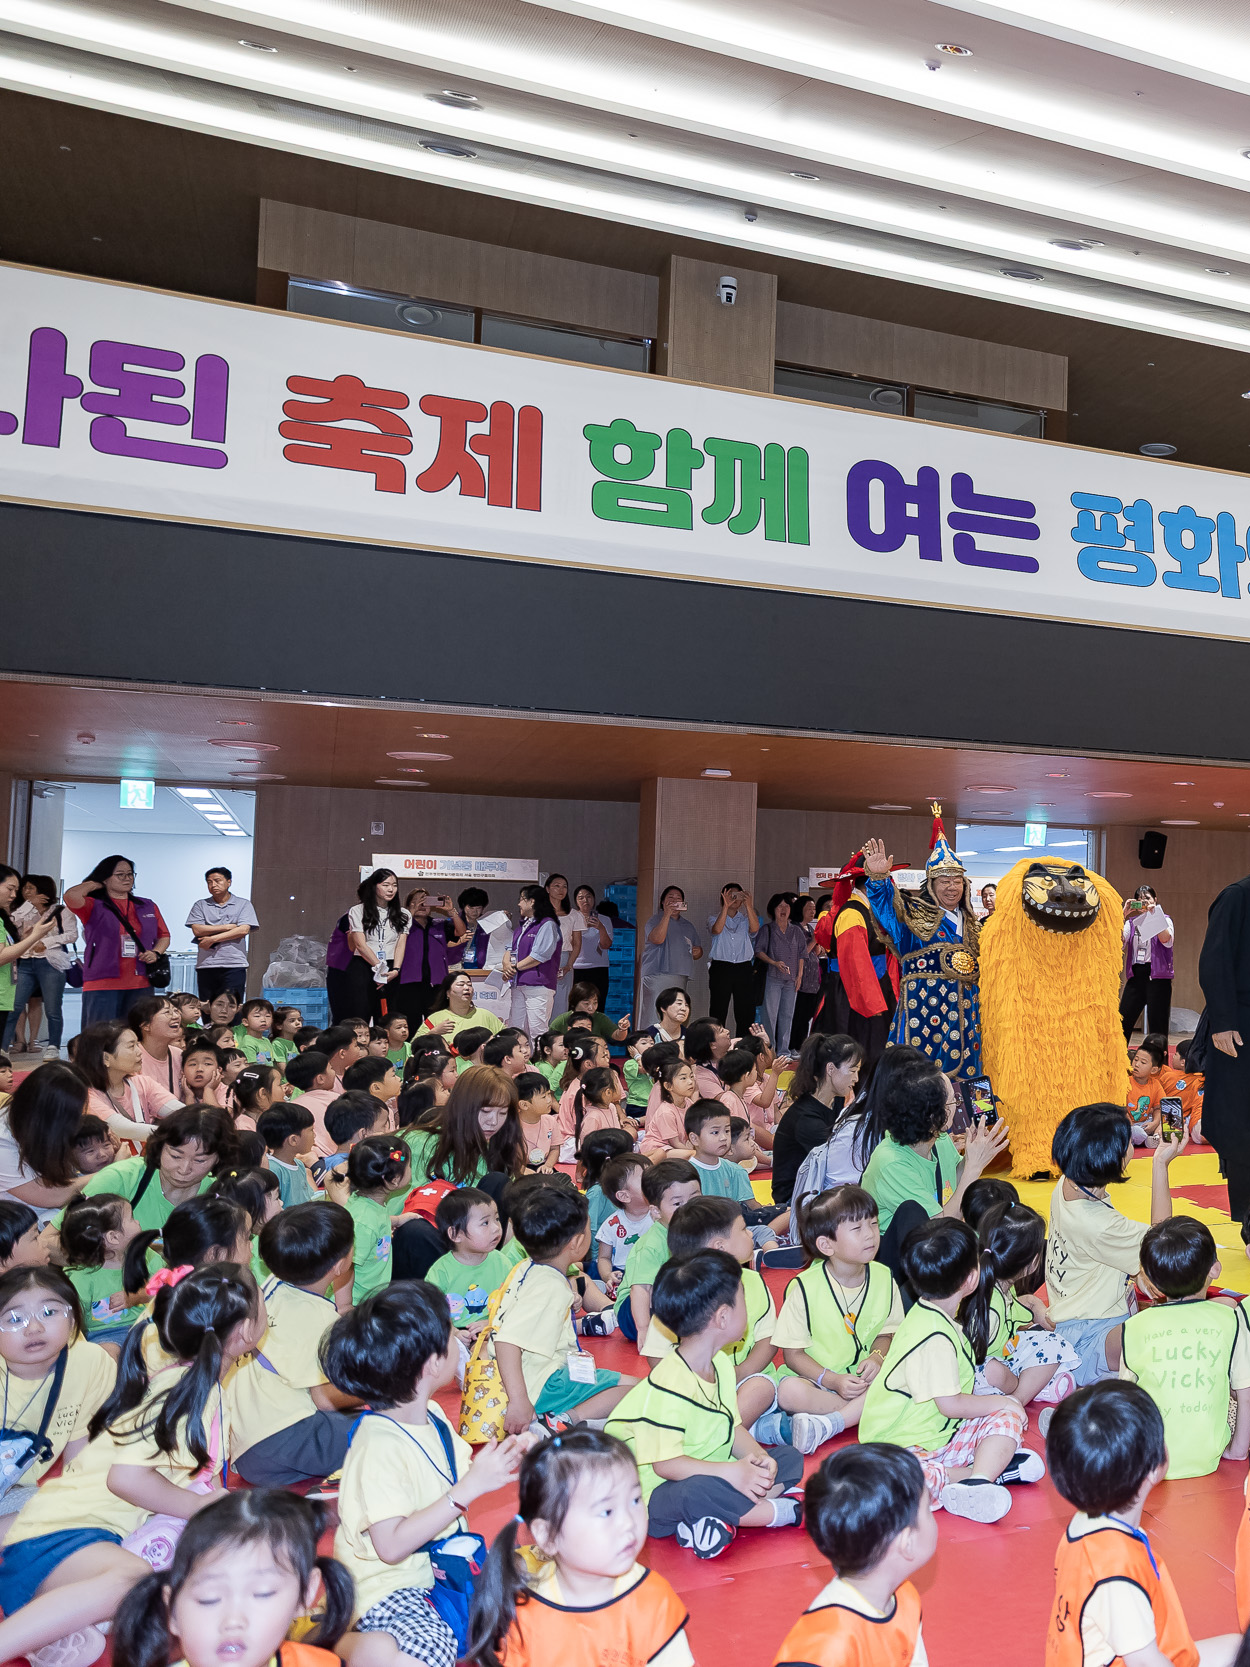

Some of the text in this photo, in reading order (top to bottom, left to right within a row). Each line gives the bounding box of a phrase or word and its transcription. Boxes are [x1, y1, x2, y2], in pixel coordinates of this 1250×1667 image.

[278, 373, 544, 513] 축제
[583, 417, 811, 546] 함께
[846, 459, 1041, 574] 여는
[404, 858, 437, 870] 어린이
[1144, 1328, 1173, 1344] Have
[1195, 1327, 1223, 1338] very
[1151, 1340, 1222, 1367] Lucky
[1151, 1367, 1217, 1394] Vicky
